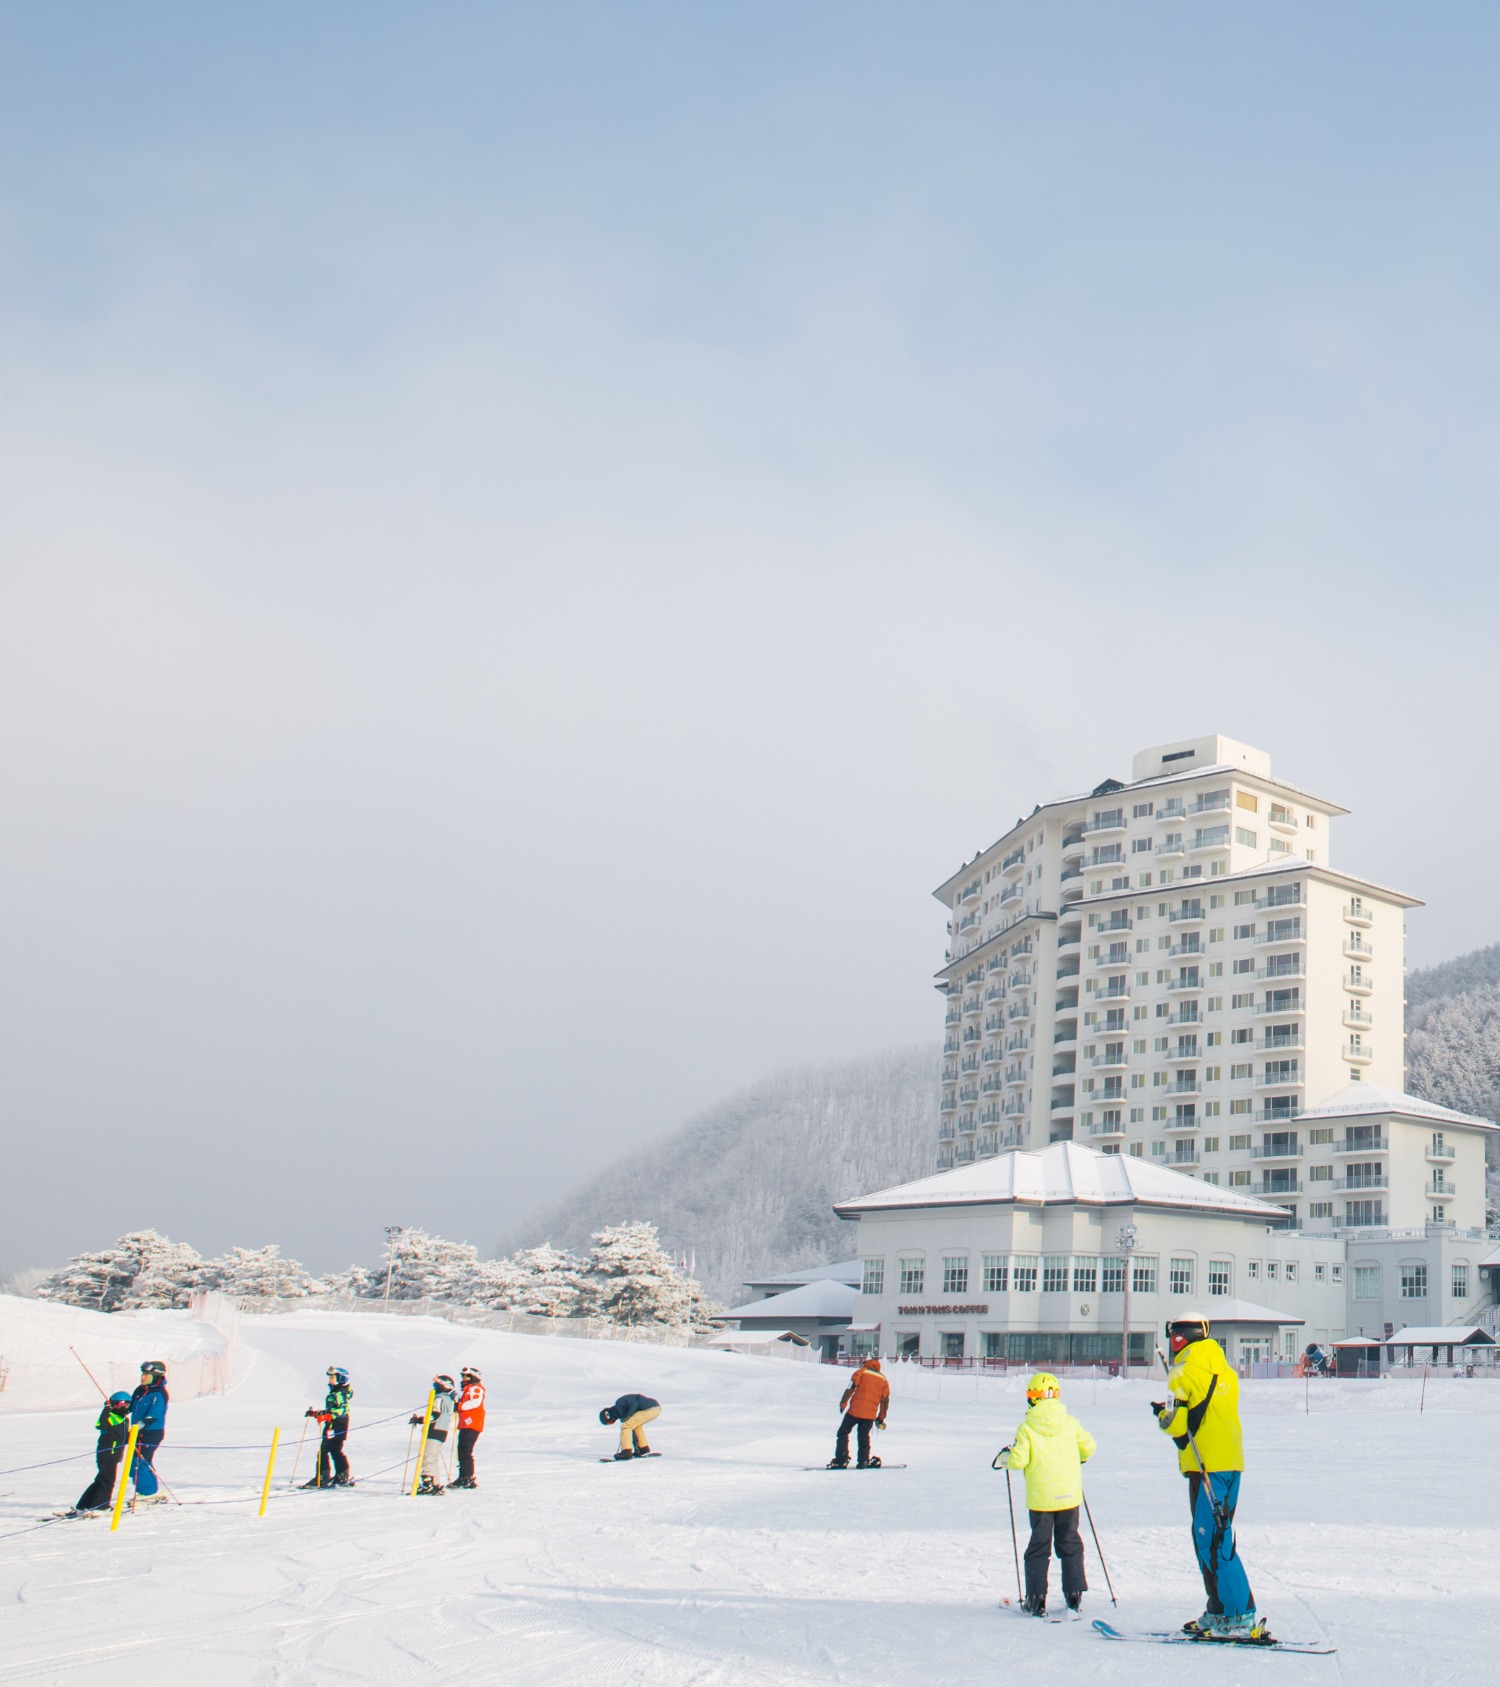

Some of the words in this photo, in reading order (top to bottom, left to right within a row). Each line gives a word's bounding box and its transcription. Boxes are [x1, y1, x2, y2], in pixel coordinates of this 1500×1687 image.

[897, 1306, 918, 1315] TOM
[918, 1306, 926, 1315] N
[926, 1305, 952, 1315] TOMS
[953, 1304, 990, 1314] COFFEE
